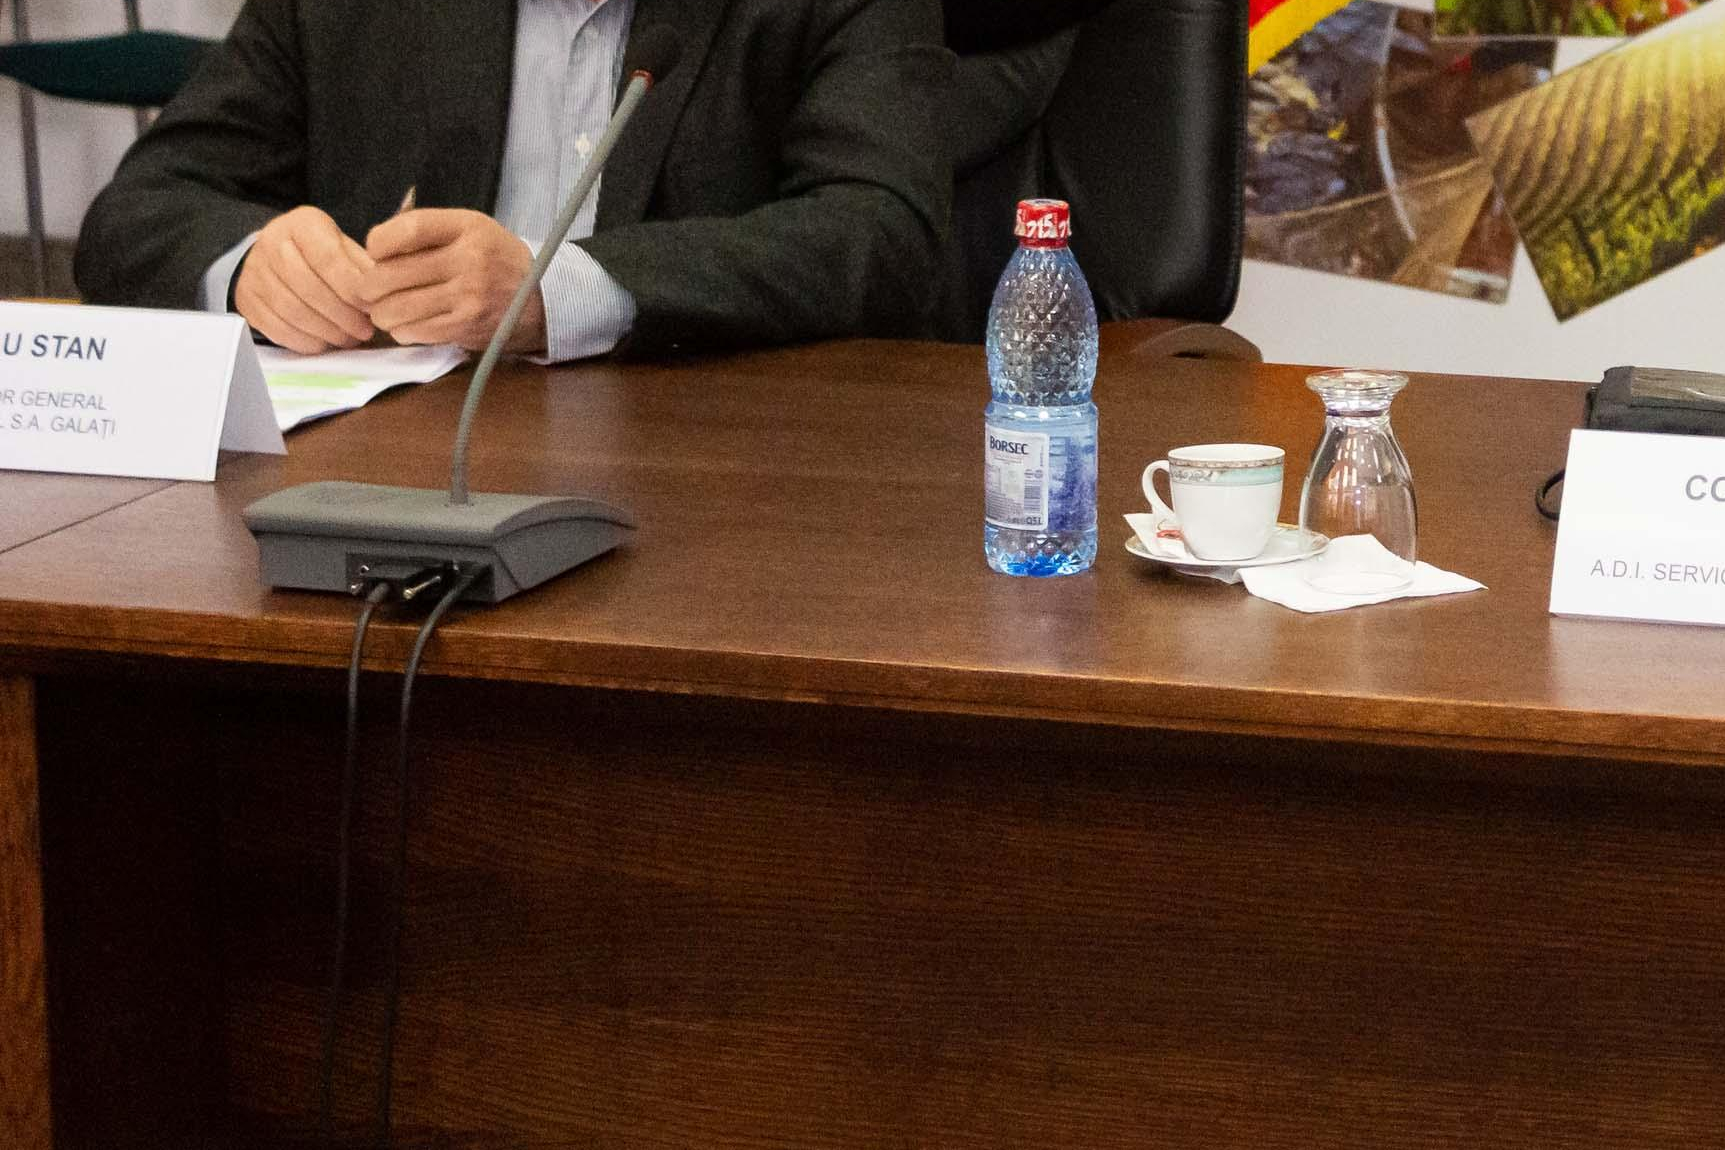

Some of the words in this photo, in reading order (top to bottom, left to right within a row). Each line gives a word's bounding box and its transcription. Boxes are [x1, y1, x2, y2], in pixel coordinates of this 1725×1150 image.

[31, 334, 107, 361] STAN
[20, 390, 107, 411] GENERAL
[989, 435, 1030, 455] BORSEC
[1590, 559, 1646, 581] A.D.I.
